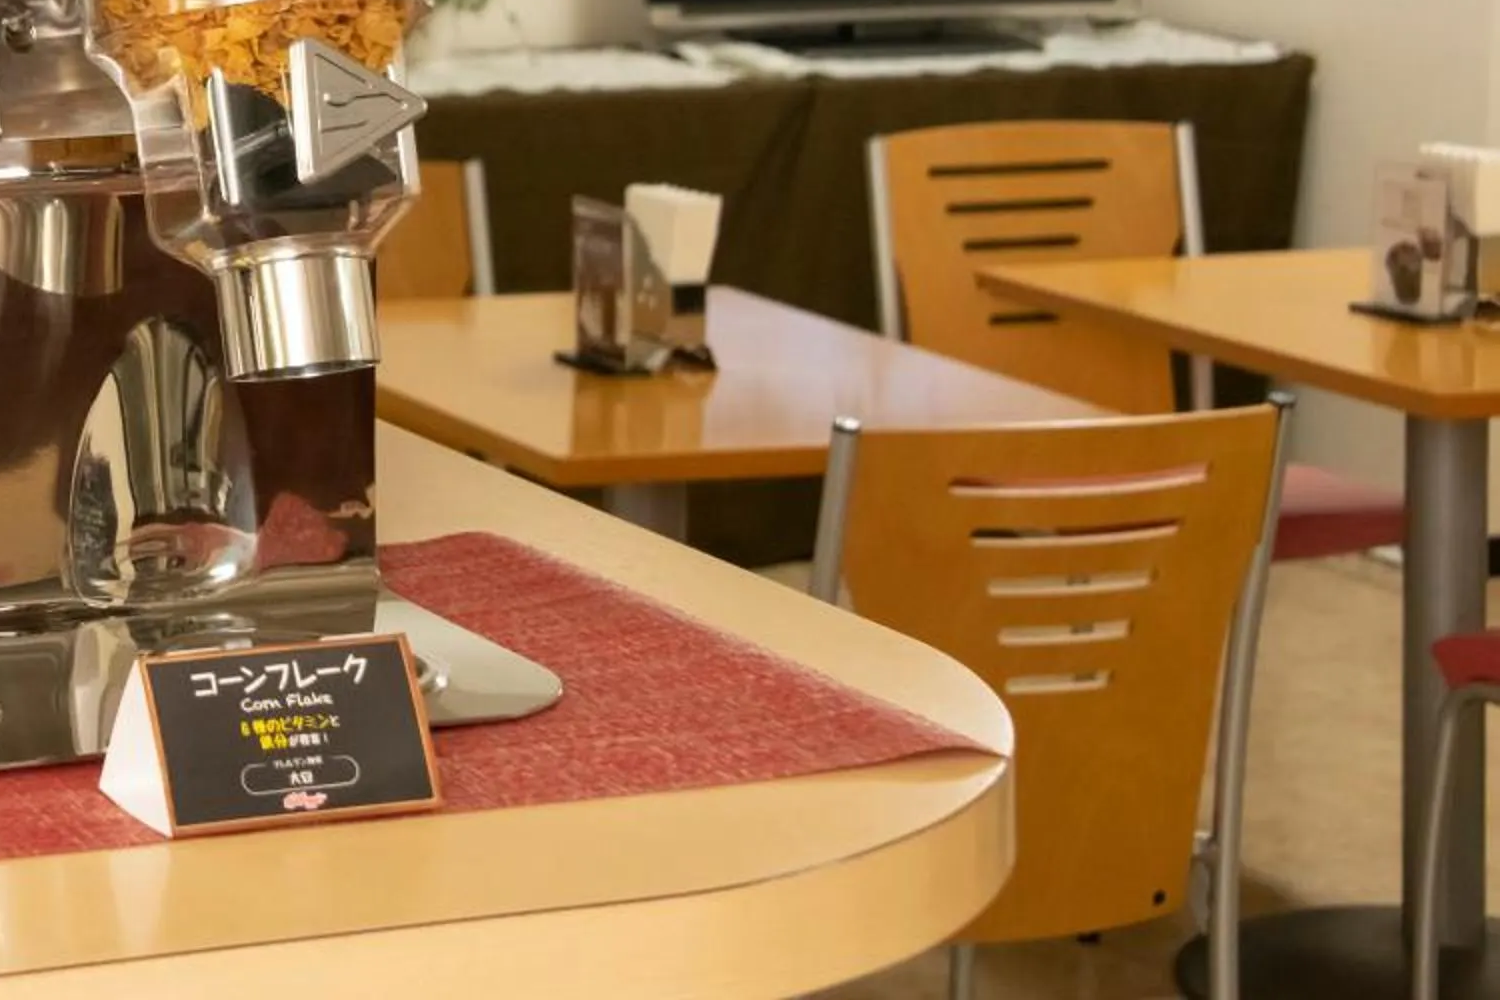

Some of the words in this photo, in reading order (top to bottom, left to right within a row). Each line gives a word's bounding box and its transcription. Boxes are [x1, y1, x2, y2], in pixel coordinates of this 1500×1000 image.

[190, 653, 368, 697] コーンフレーク
[240, 696, 283, 713] Corn
[286, 691, 334, 708] Flake
